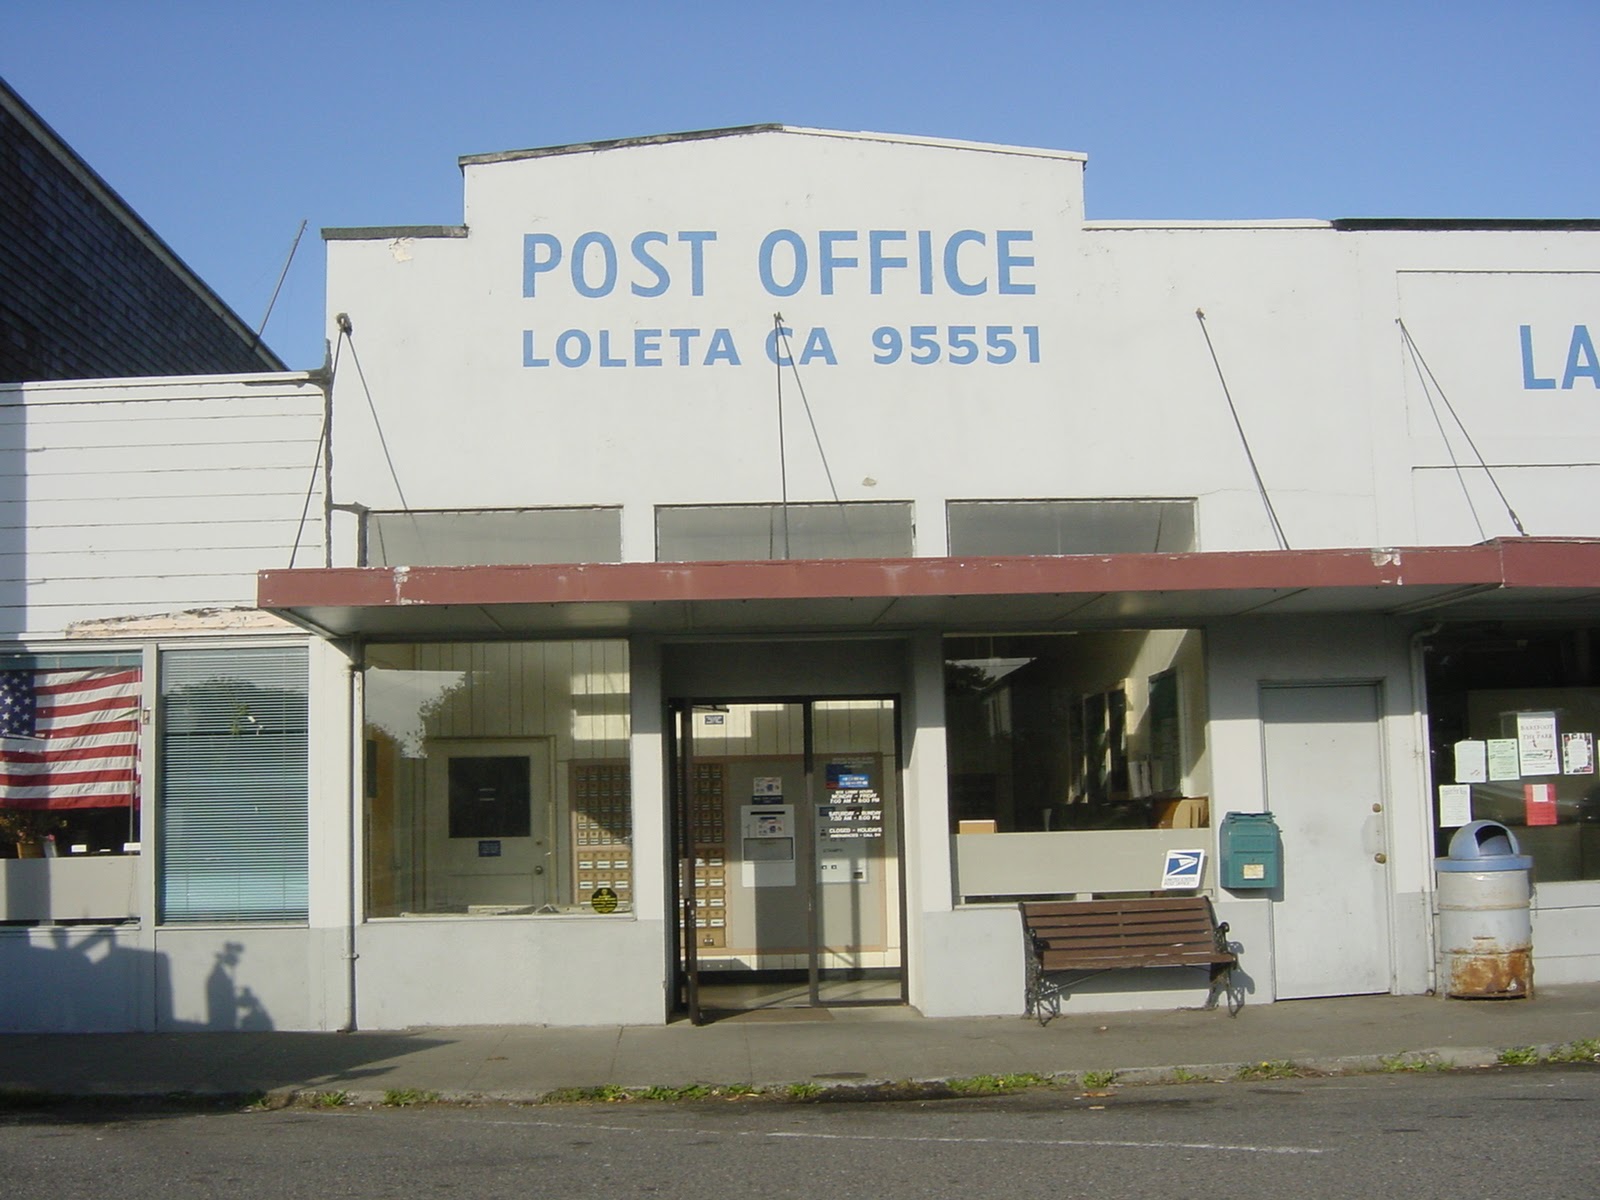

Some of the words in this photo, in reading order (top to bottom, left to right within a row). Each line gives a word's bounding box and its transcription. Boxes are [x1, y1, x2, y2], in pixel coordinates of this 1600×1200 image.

[522, 230, 718, 299] POST
[758, 229, 1037, 297] OFFICE
[522, 327, 742, 368] LOLETA
[765, 327, 838, 367] CA
[871, 325, 1041, 366] 95551
[1519, 324, 1600, 390] LA
